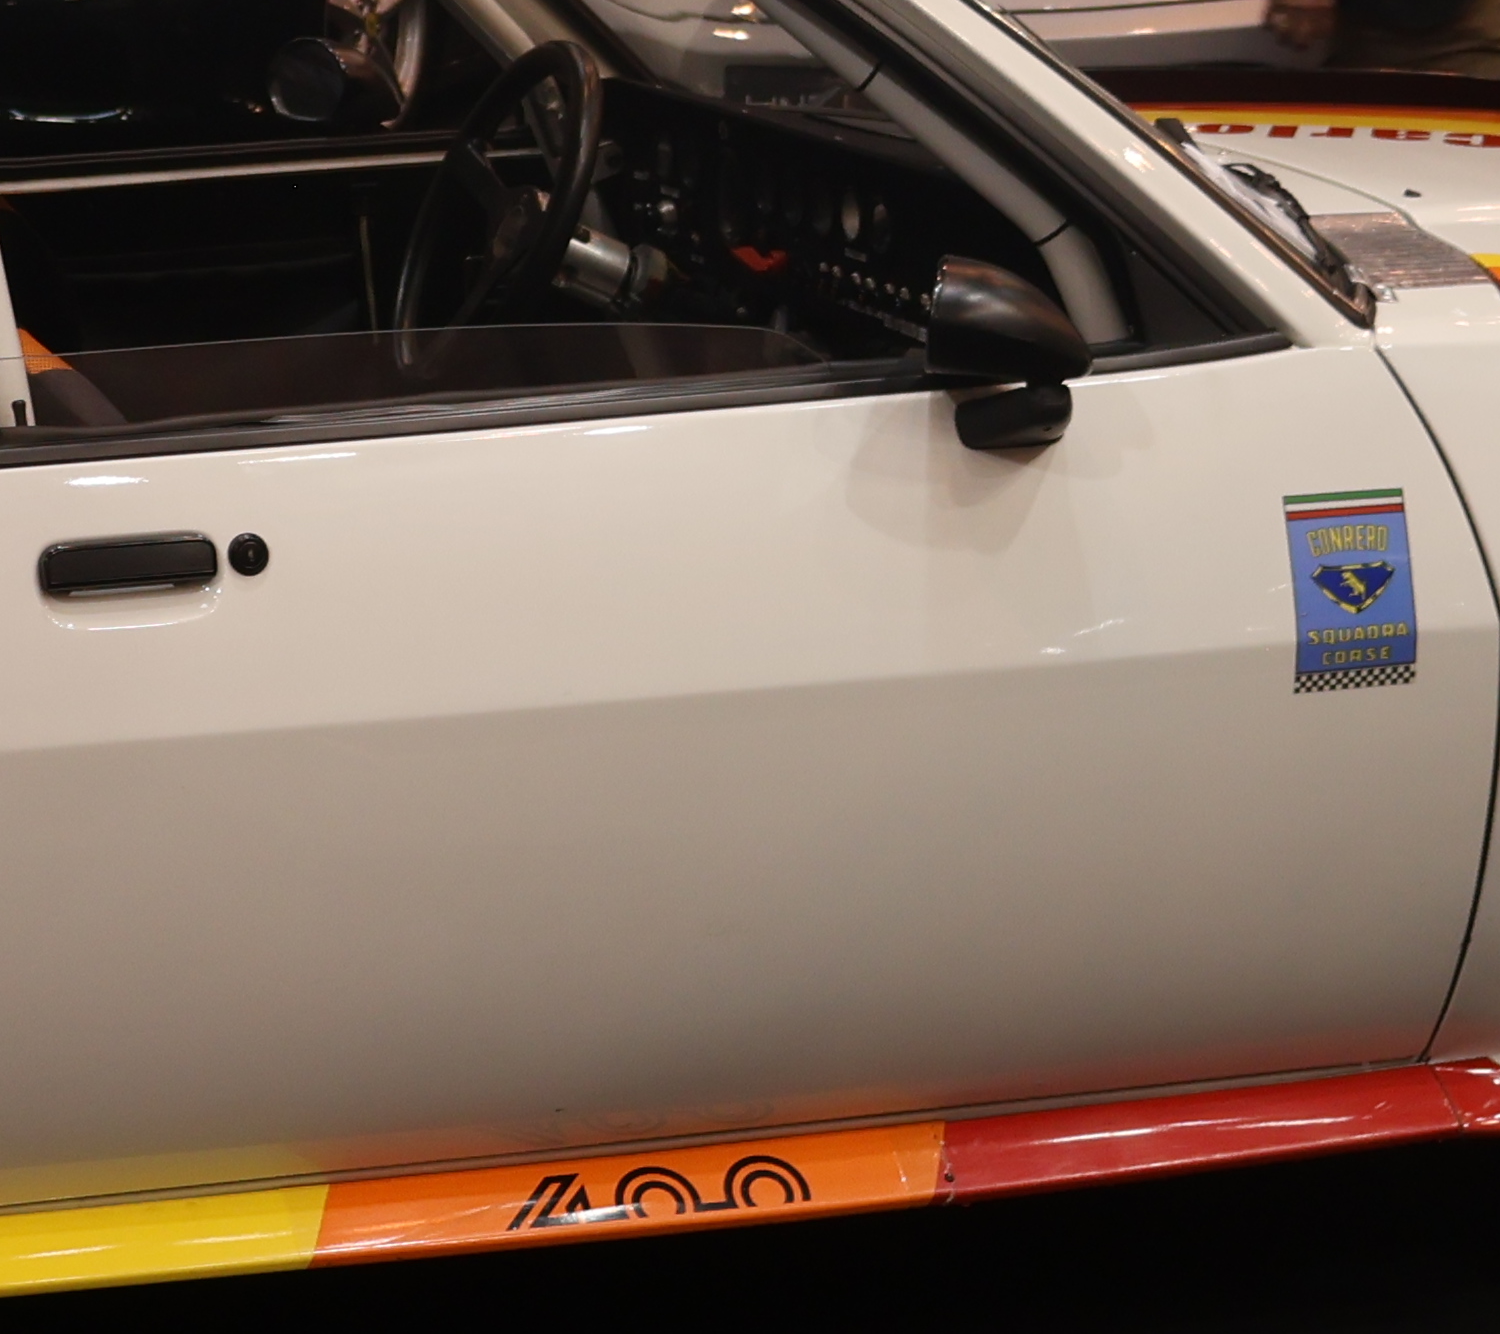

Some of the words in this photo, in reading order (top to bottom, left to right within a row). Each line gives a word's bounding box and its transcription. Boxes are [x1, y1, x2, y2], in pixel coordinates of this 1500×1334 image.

[1306, 524, 1389, 558] CONRERO
[1306, 622, 1410, 646] SQUADRA
[1322, 646, 1392, 666] CORSE
[505, 1154, 813, 1233] 400
